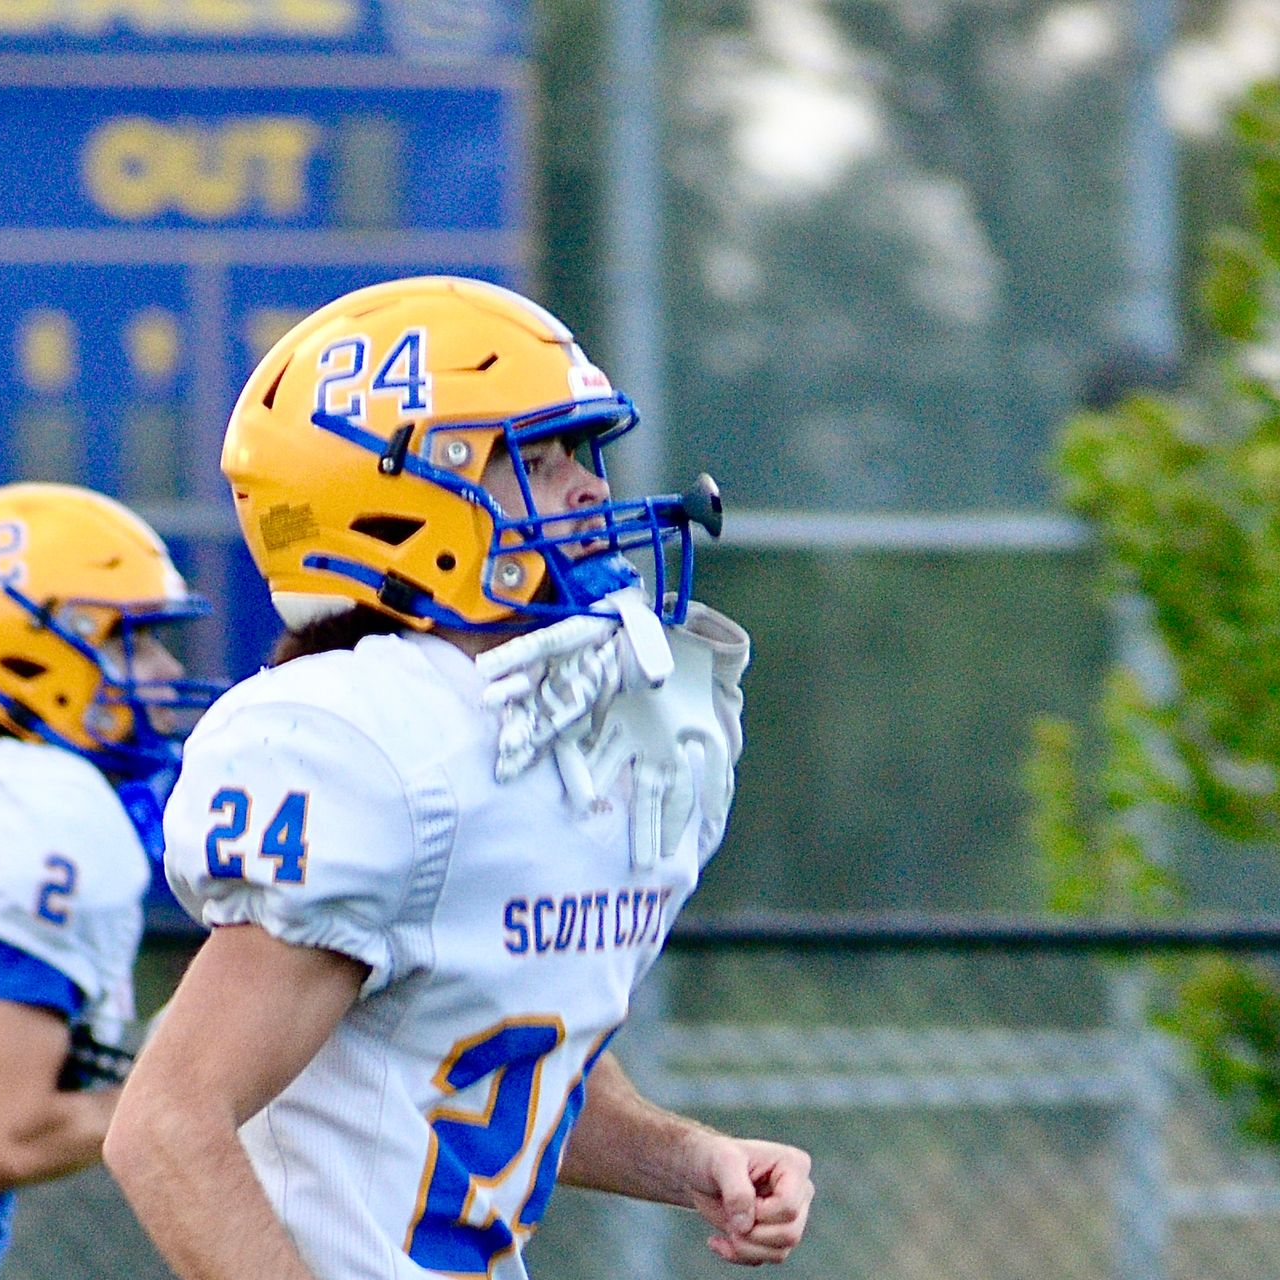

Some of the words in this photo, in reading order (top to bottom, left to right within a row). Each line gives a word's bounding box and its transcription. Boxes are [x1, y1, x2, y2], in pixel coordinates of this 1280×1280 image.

[81, 114, 320, 220] OUT
[312, 325, 433, 424] 24
[205, 786, 311, 885] 24
[35, 852, 78, 925] 2
[502, 890, 609, 956] SCOTT
